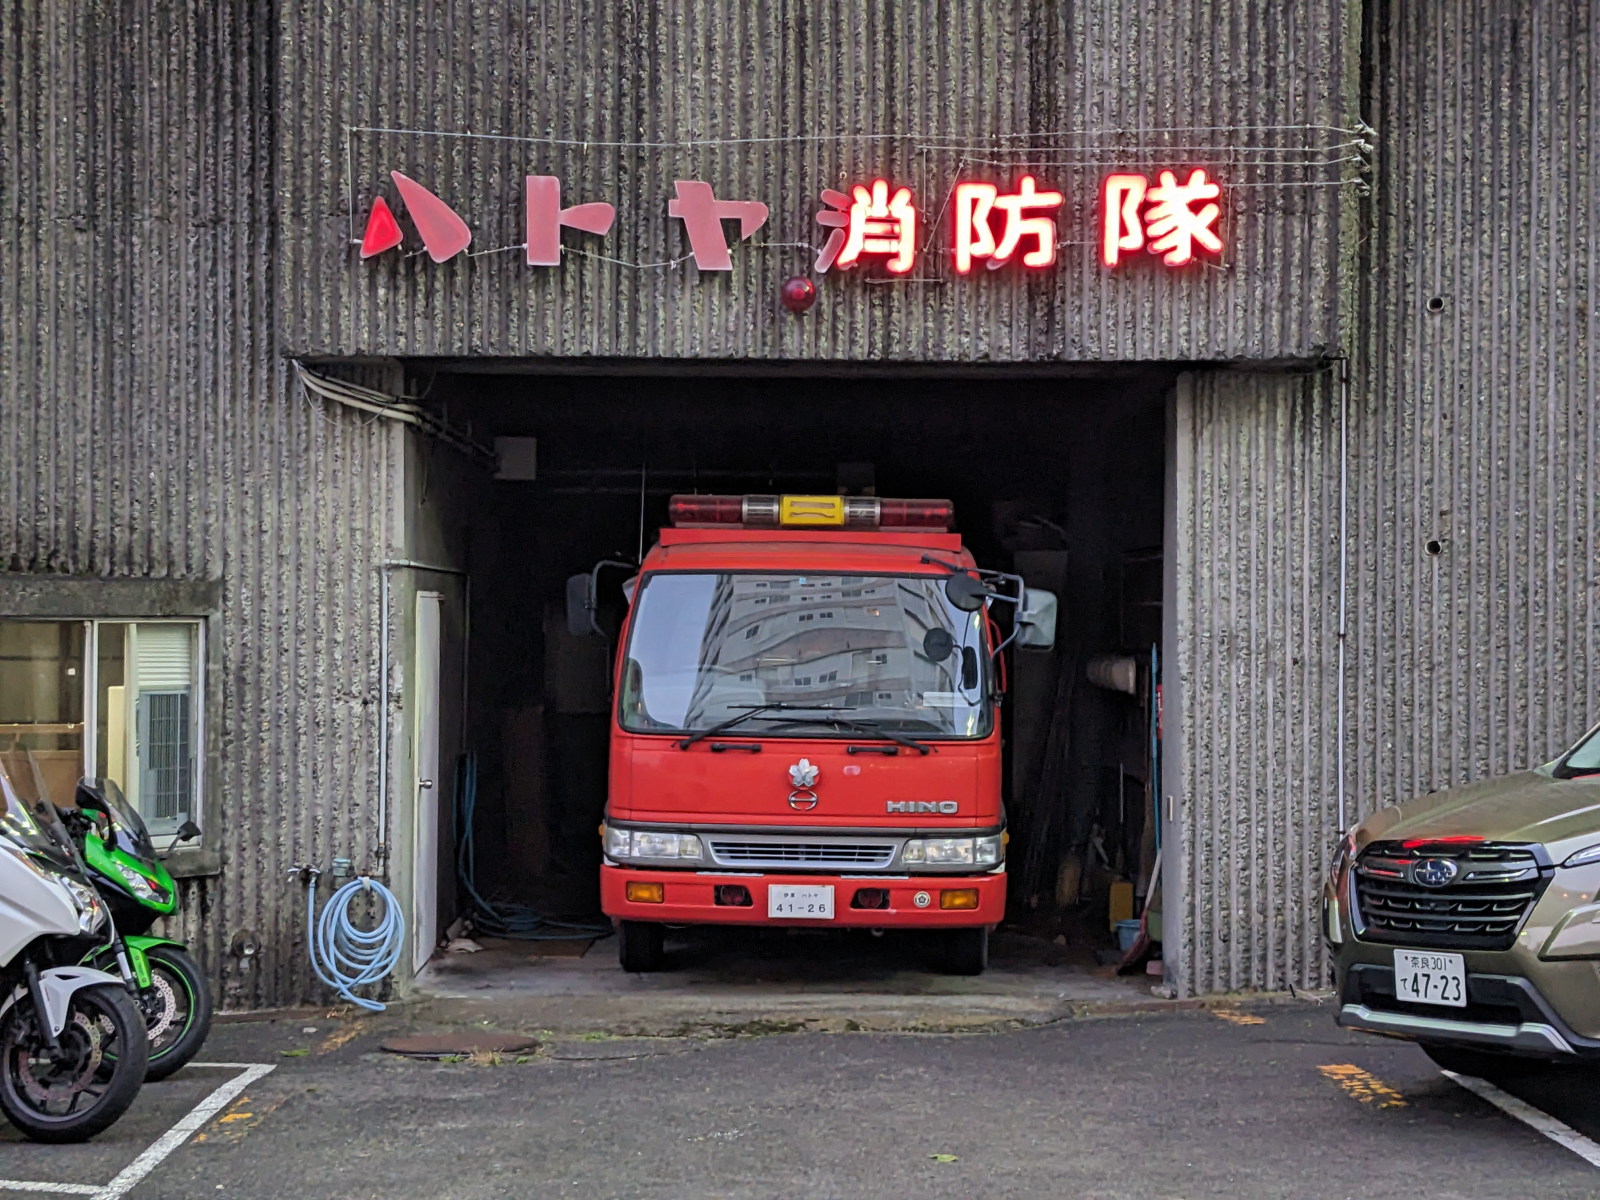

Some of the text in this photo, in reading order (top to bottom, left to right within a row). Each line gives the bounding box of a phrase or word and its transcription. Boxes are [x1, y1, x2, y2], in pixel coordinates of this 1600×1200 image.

[886, 800, 958, 814] HINO
[776, 903, 826, 913] 41-26
[1411, 972, 1461, 1001] 47-23
